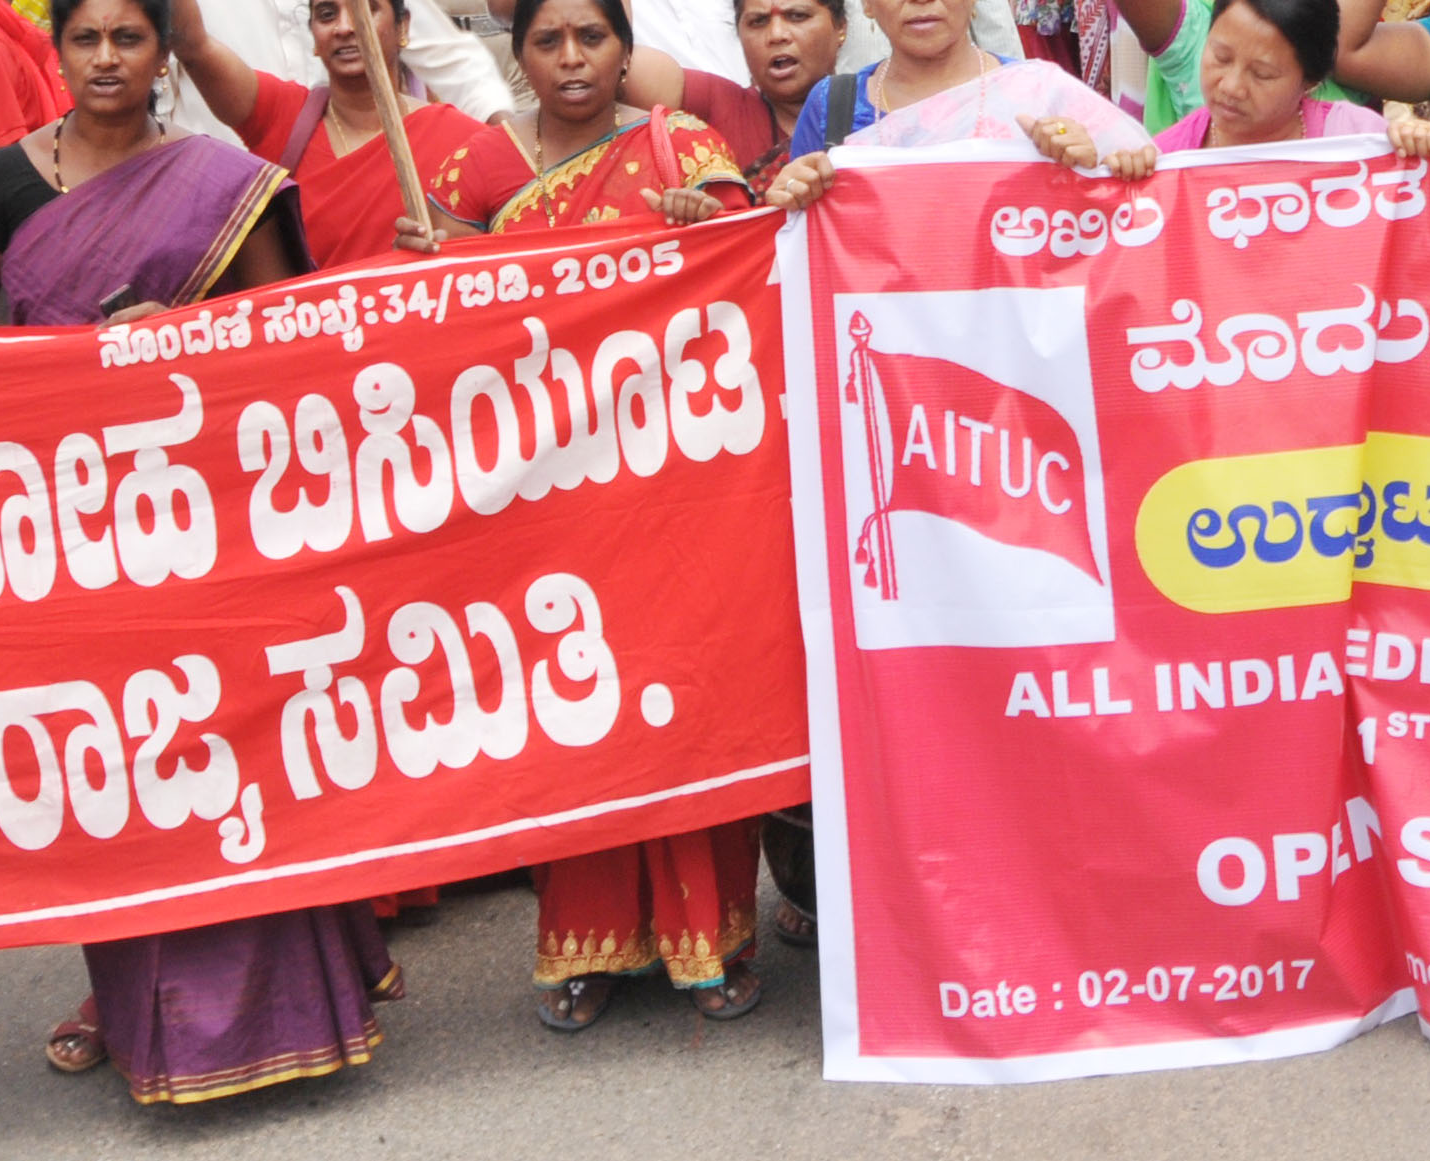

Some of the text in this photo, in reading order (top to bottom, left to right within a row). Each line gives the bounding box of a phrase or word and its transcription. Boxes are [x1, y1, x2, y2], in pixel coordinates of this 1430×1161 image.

[990, 189, 1165, 259] ಅಖಿಲ
[1206, 156, 1429, 250] ಭಾರತ
[553, 240, 685, 295] 2005
[234, 297, 767, 561] ಬಿಸಿಯೂಟ
[901, 401, 1073, 515] AITUC
[1005, 662, 1131, 719] ALL
[1153, 651, 1345, 714] INDIA
[938, 977, 1037, 1021] Date
[1077, 957, 1316, 1010] 02-07-2017
